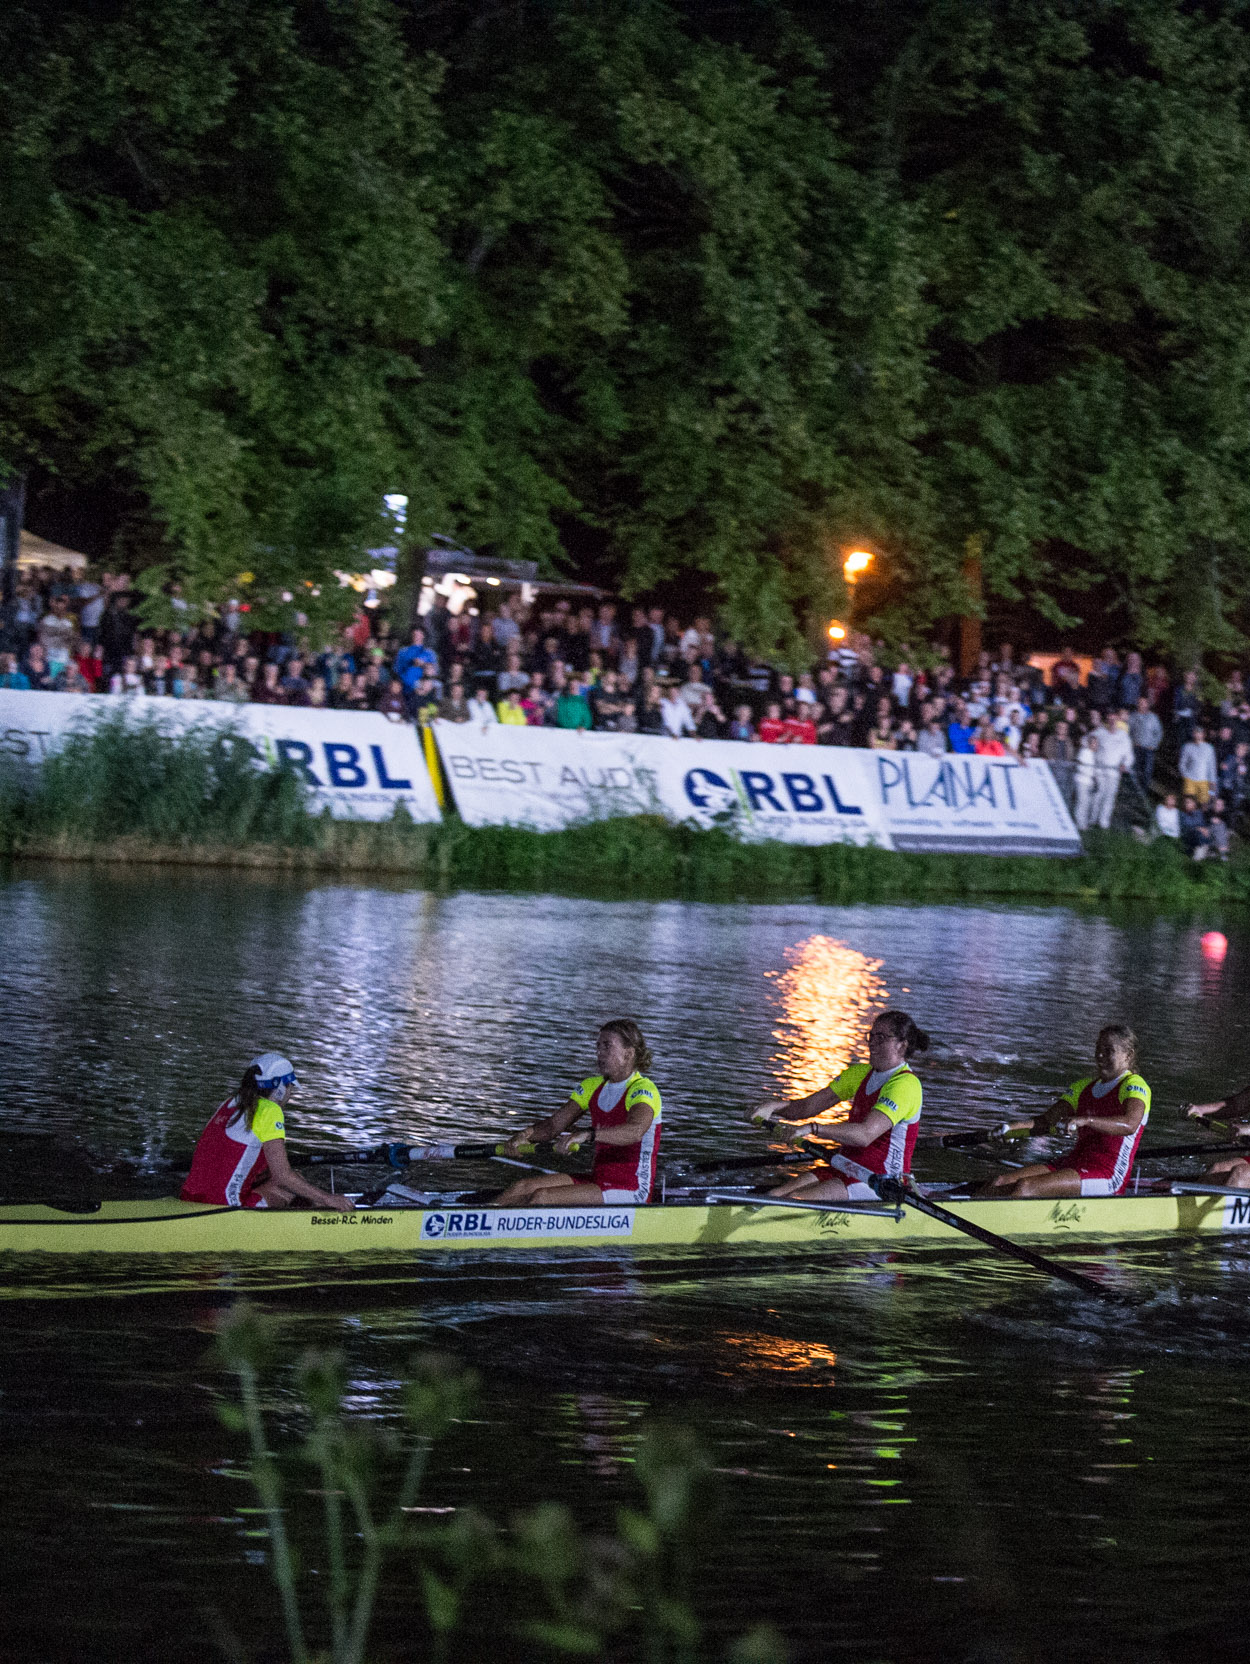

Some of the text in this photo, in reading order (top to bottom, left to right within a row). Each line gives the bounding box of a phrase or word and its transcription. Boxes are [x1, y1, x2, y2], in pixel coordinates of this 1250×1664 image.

[0, 730, 50, 756] ST
[274, 739, 413, 790] RBL
[449, 755, 544, 785] BEST
[738, 770, 863, 816] RBL
[360, 1215, 394, 1225] Minden
[447, 1213, 492, 1232] RBL
[497, 1214, 631, 1232] RUDER-BUNDESLIGA
